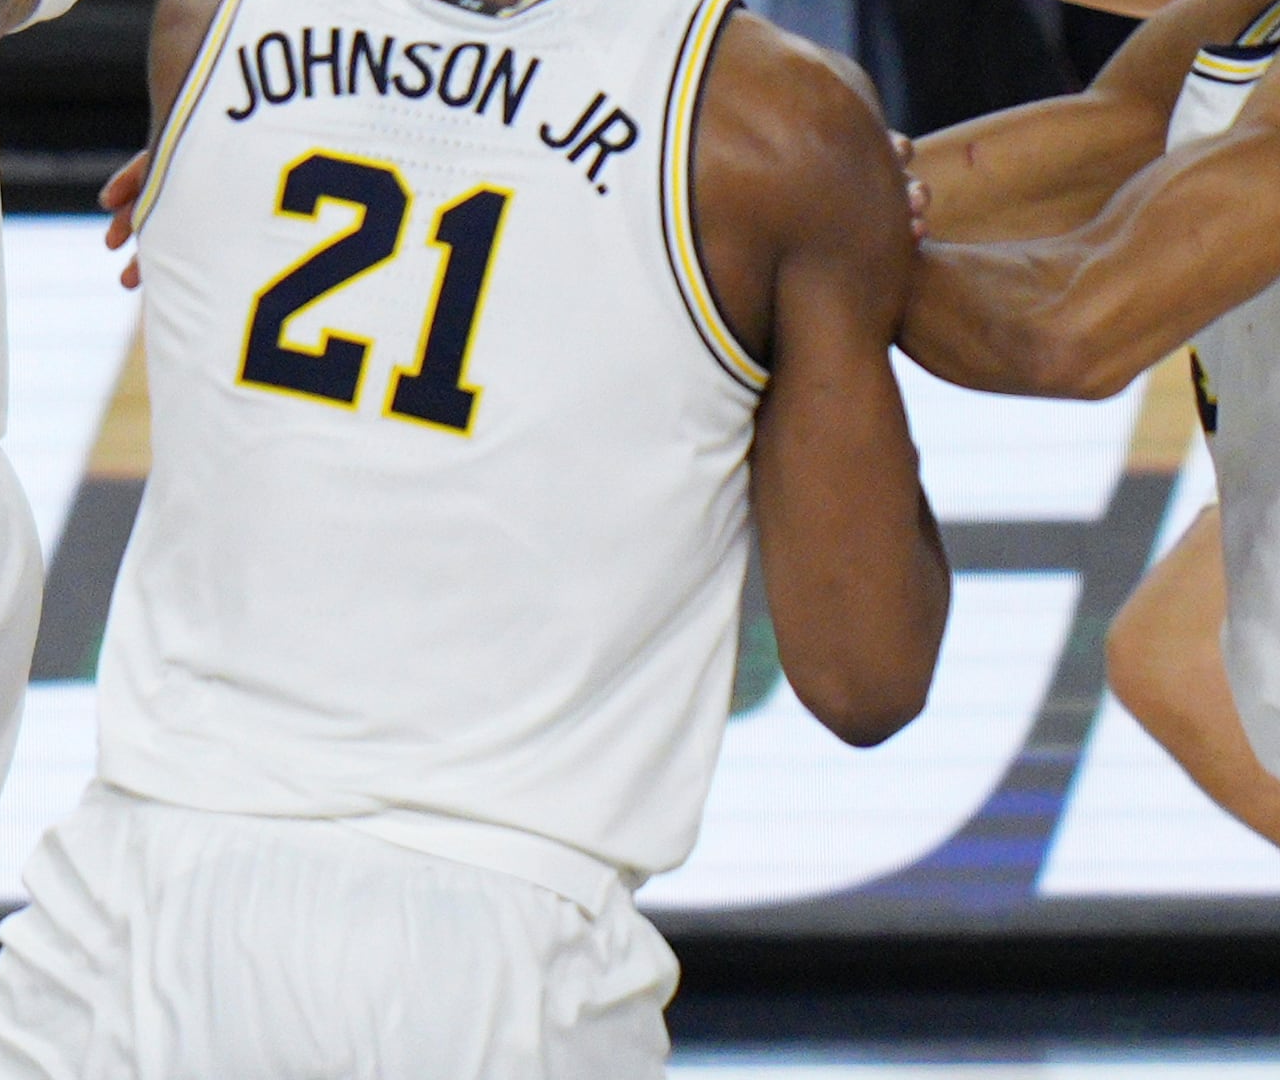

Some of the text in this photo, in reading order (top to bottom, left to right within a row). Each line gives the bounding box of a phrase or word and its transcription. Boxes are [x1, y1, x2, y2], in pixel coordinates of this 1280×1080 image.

[226, 26, 639, 195] JOHNSON JR.
[234, 146, 516, 439] 21
